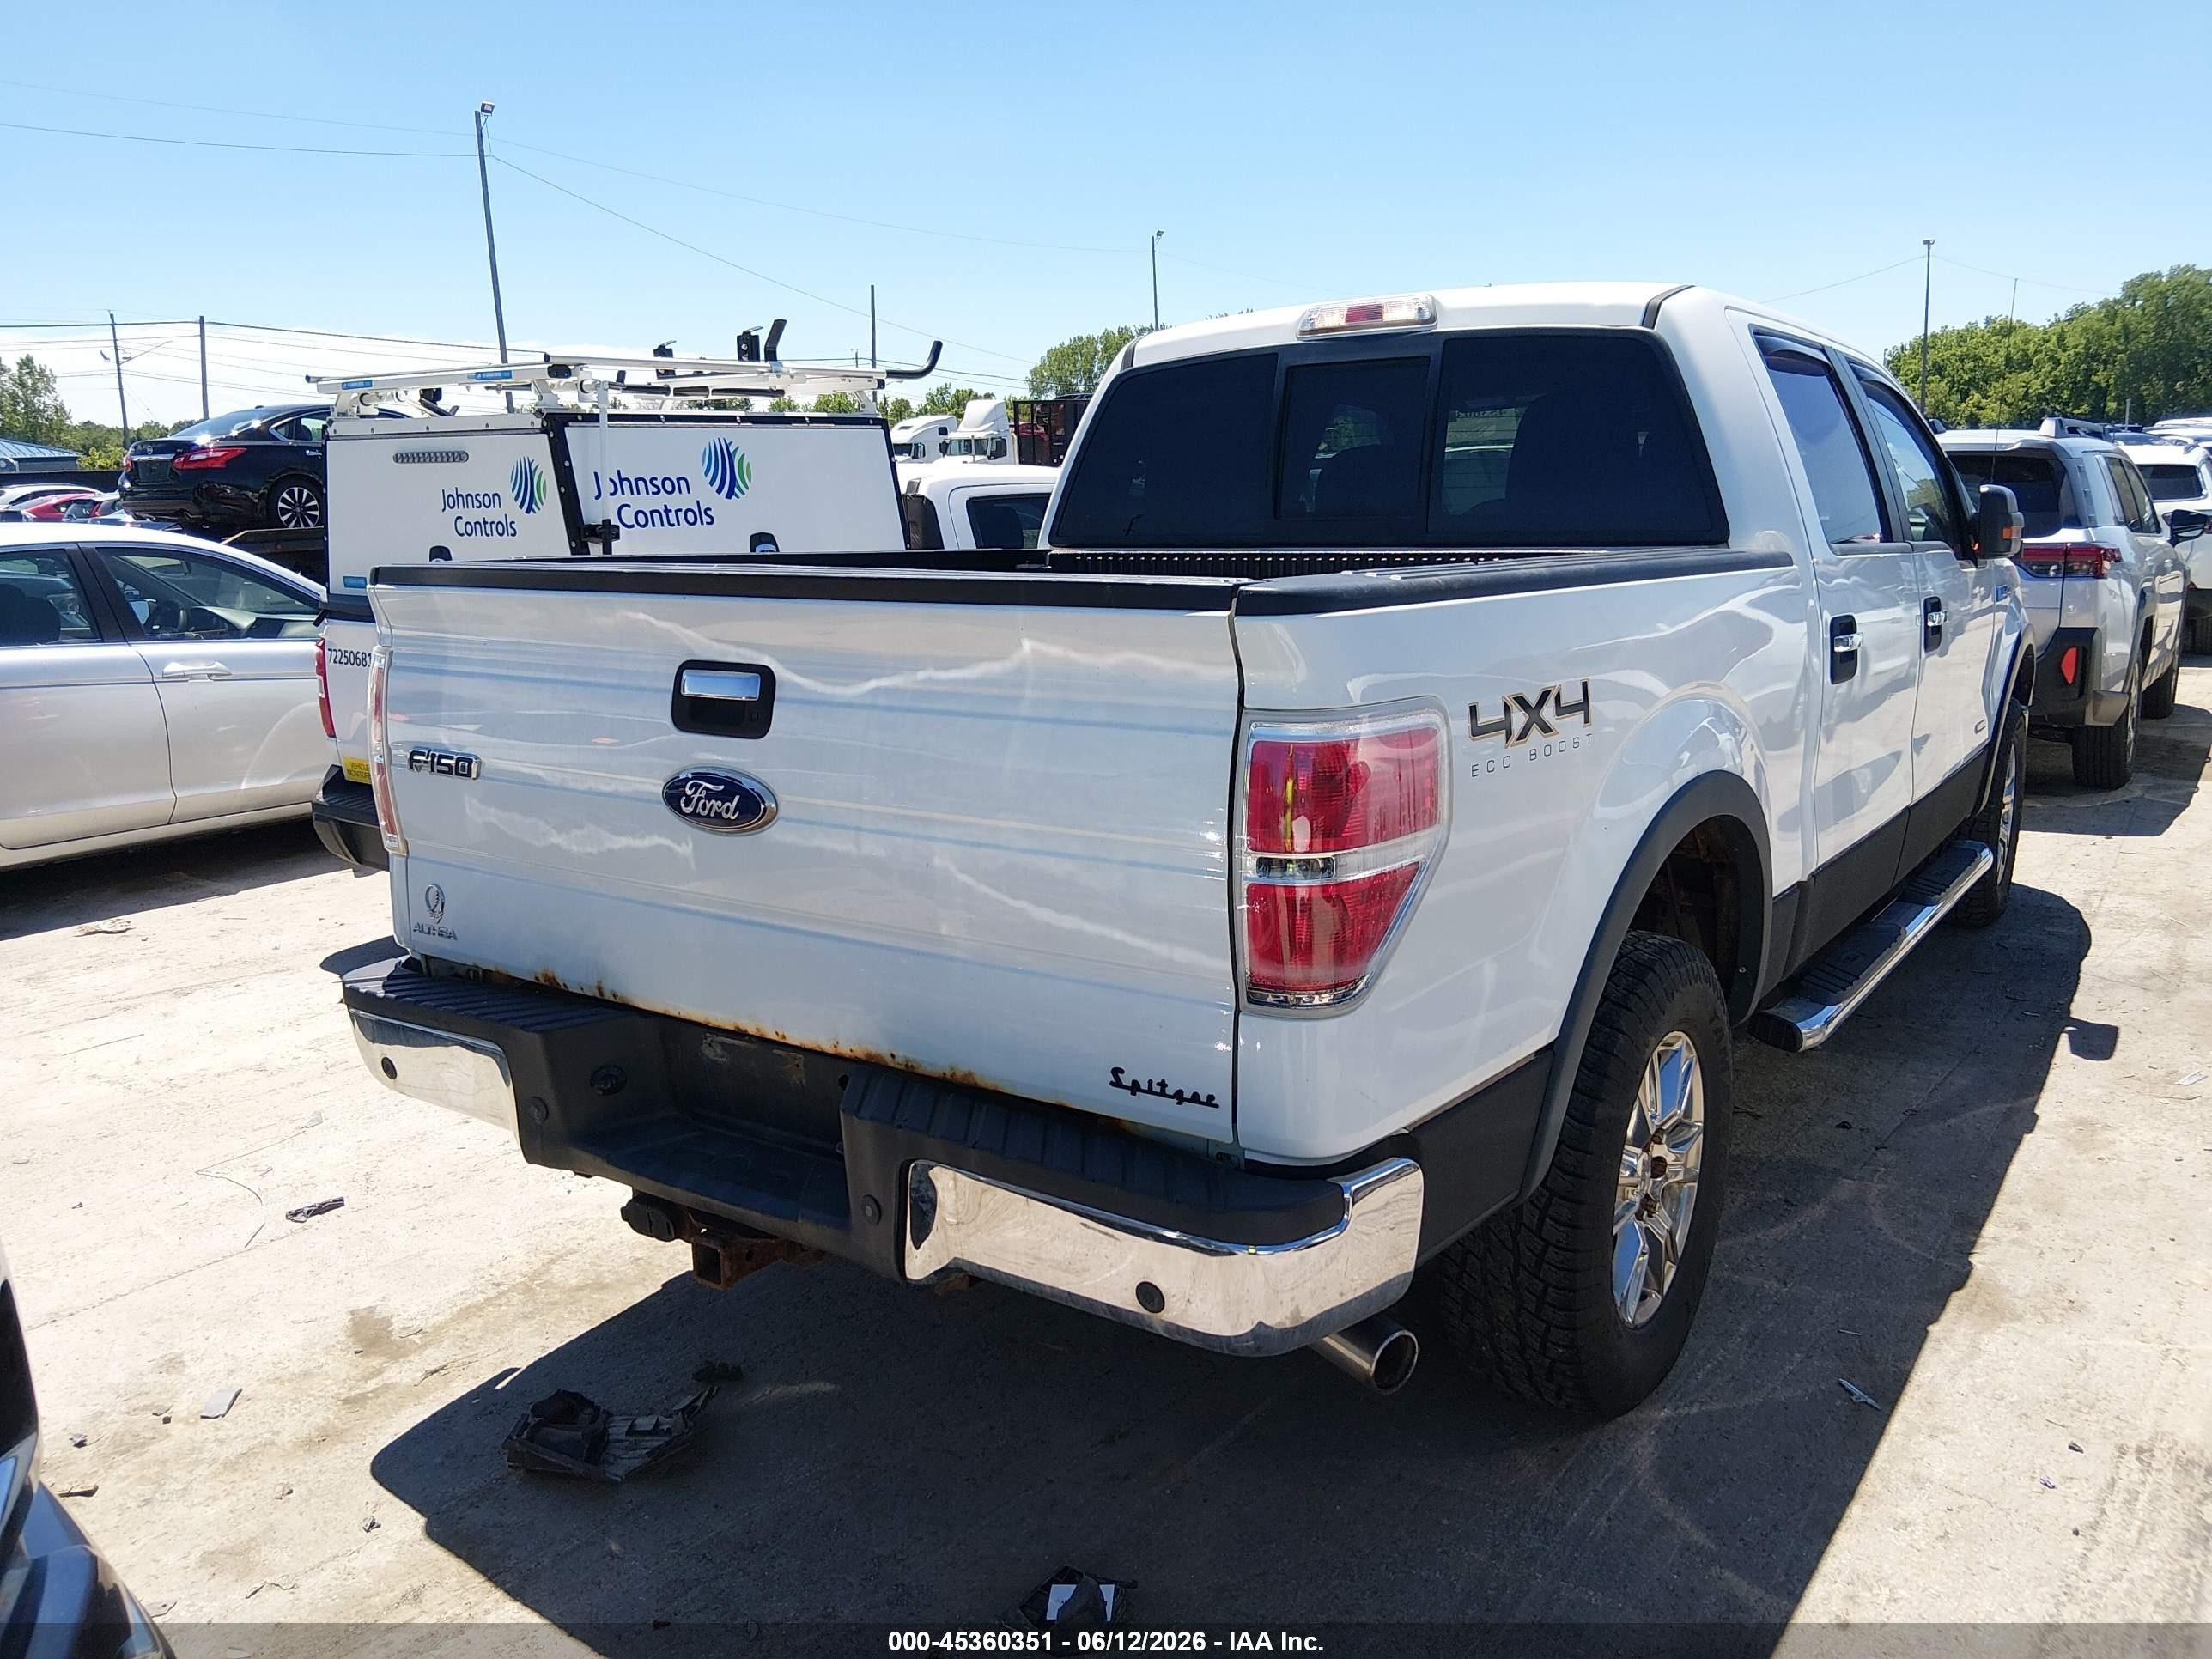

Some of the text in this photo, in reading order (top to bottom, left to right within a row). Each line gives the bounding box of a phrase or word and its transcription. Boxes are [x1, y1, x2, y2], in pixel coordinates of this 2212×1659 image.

[592, 470, 690, 500] Johnson
[441, 487, 501, 513] Johnson
[617, 500, 715, 529] Controls
[453, 514, 517, 537] Controls
[1471, 733, 1592, 778] ECO BOOST
[680, 780, 740, 820] Ford
